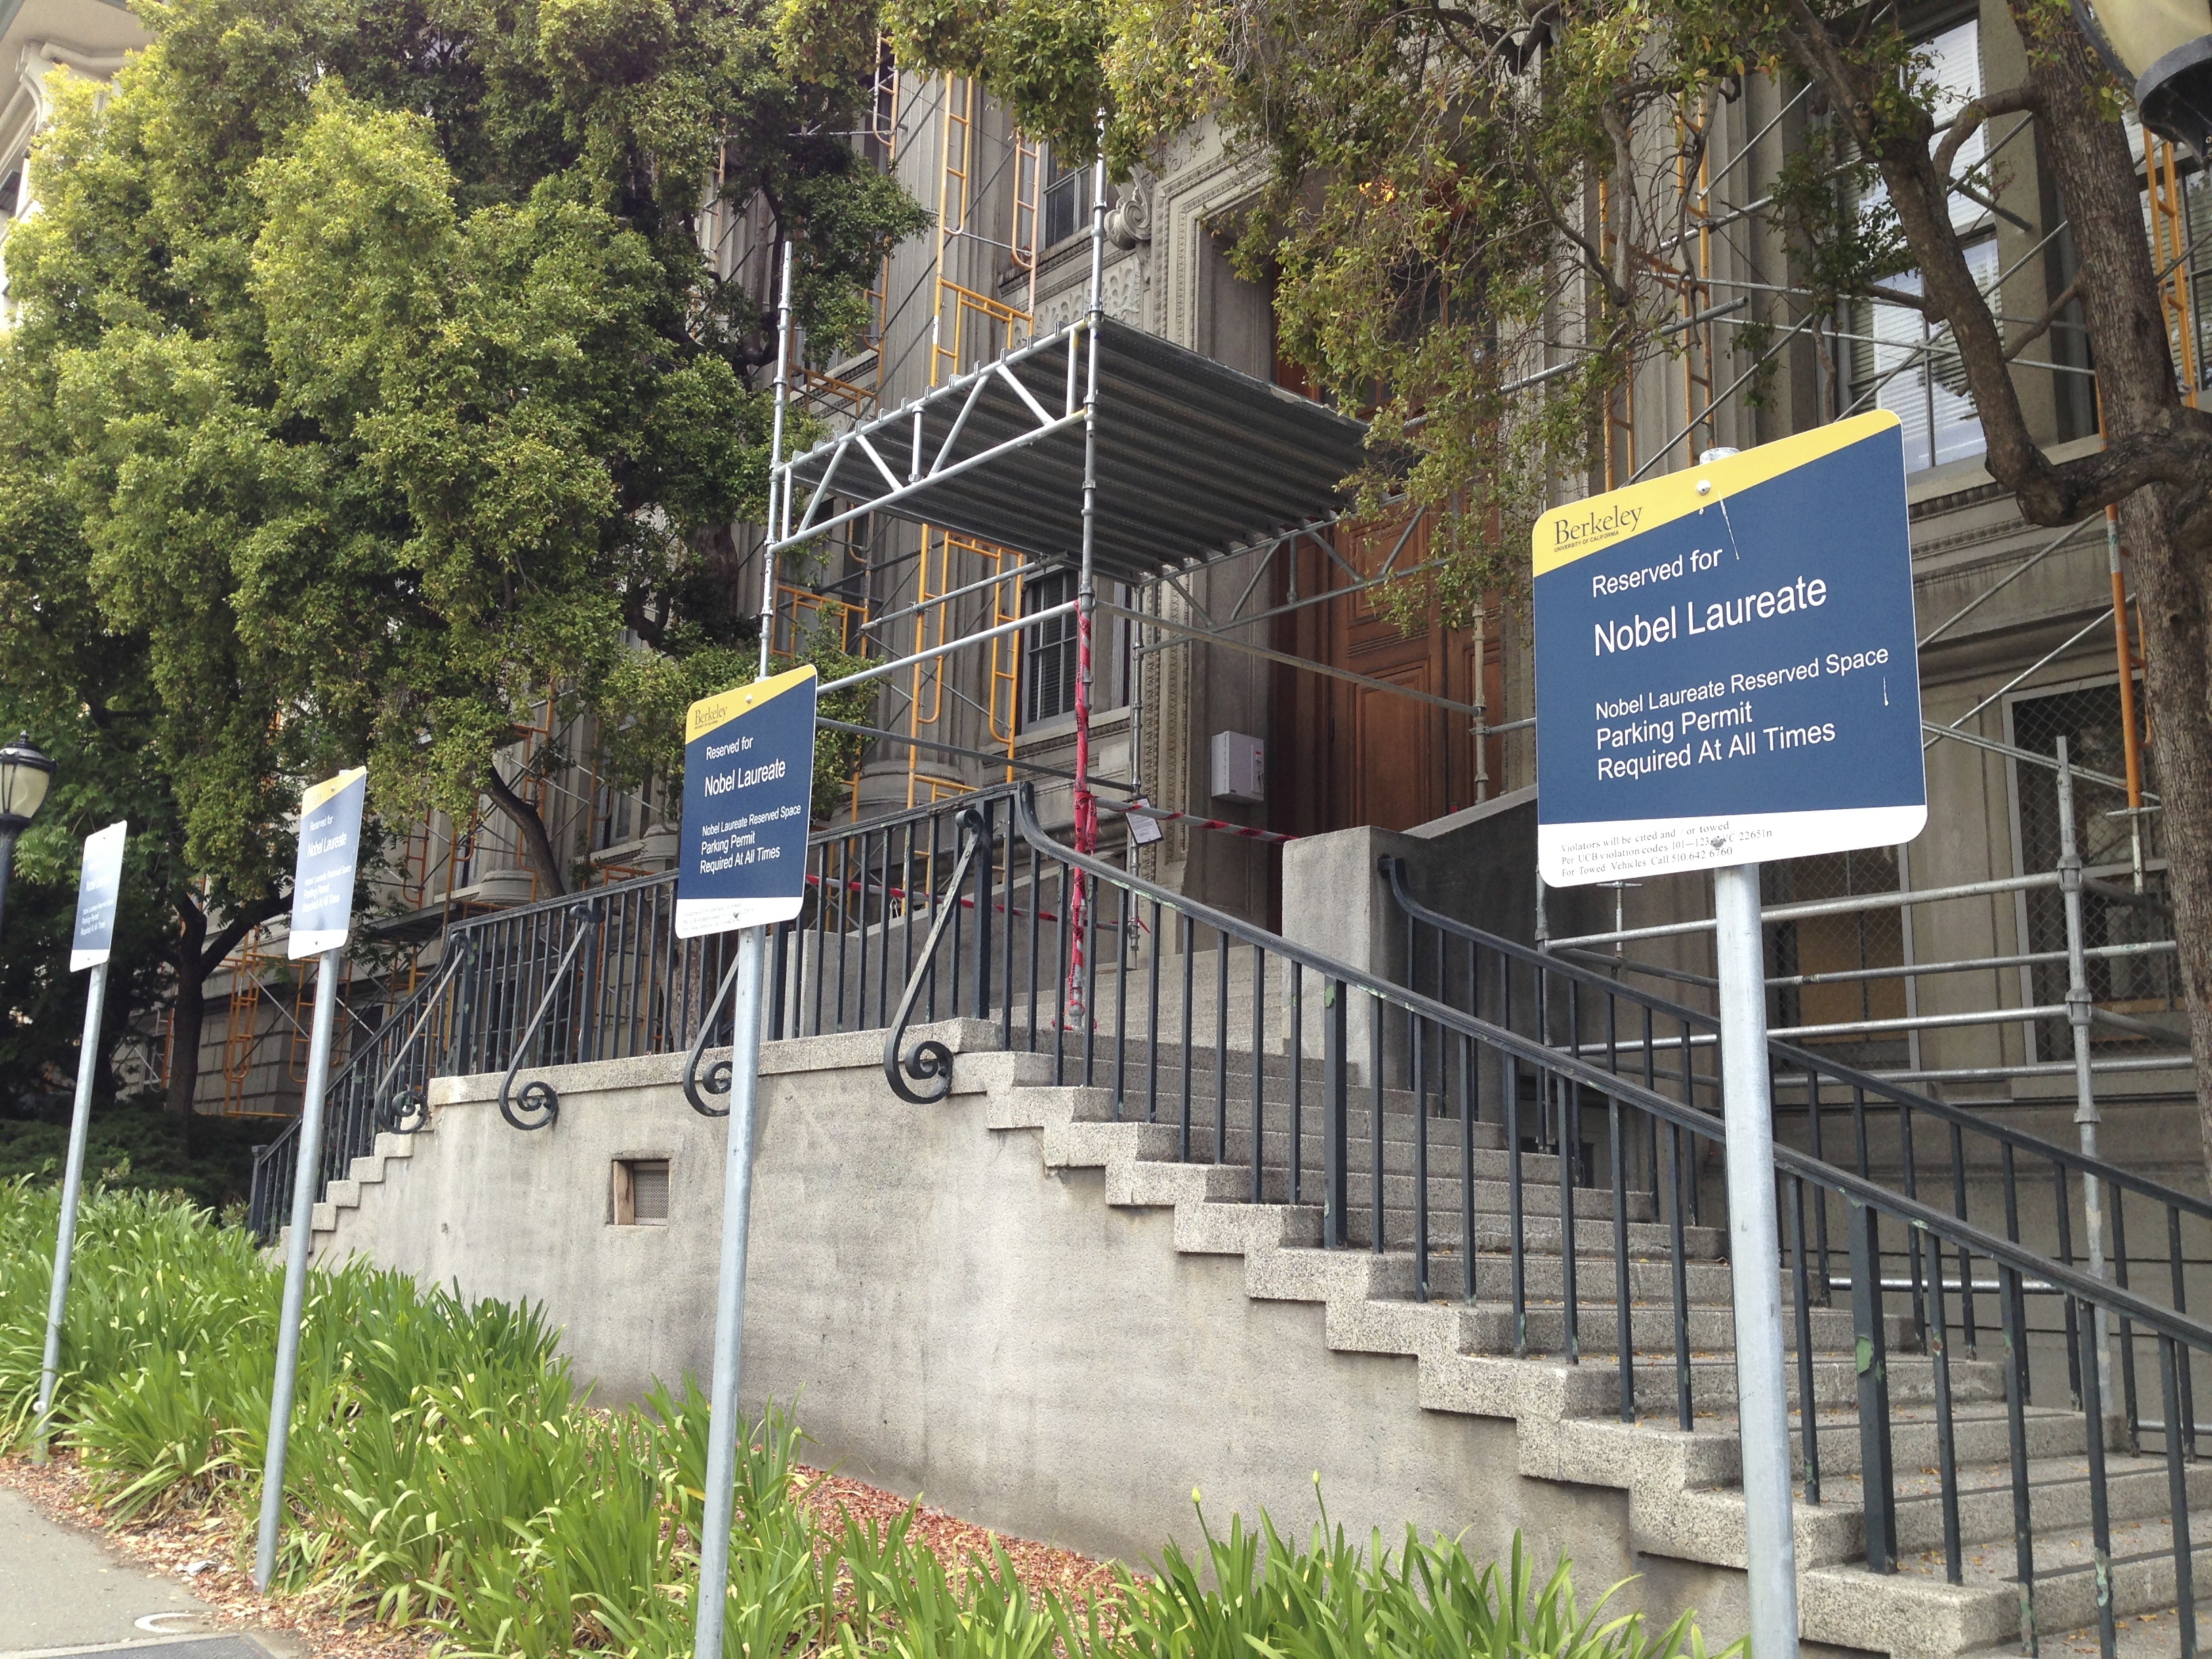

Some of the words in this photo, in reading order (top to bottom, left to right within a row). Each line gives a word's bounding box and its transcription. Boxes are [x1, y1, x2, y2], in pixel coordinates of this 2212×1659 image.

[1553, 505, 1643, 545] Berkeley
[1554, 541, 1581, 552] UNIVERSITY
[1591, 531, 1620, 542] CALIFORNIA
[1592, 555, 1683, 598] Reserved
[1689, 548, 1723, 573] for
[1594, 606, 1677, 657] Nobel
[1687, 575, 1828, 635] Laureate
[1595, 694, 1643, 720] Nobel
[1648, 680, 1725, 710] Laureate
[1730, 657, 1819, 693] Reserved
[1825, 648, 1889, 676] Space
[695, 704, 727, 725] Berkeley
[1597, 719, 1674, 750] Parking
[1681, 701, 1753, 735] Permit
[706, 738, 739, 760] Reserved
[741, 736, 754, 750] for
[1597, 743, 1691, 781] Required
[1698, 739, 1722, 764] At
[1728, 731, 1756, 758] All
[1763, 722, 1836, 752] Times
[704, 769, 735, 797] Nobel
[737, 758, 786, 789] Laureate
[701, 822, 720, 837] Nobel
[720, 817, 747, 833] Laureate
[749, 807, 779, 826] Reserved
[780, 804, 802, 820] Space
[701, 838, 729, 855] Parking
[731, 830, 756, 848] Permit
[1561, 842, 1601, 853] Violators
[1603, 836, 1619, 846] will
[1622, 836, 1631, 844] be
[1635, 832, 1658, 842] cited
[1660, 829, 1675, 839] and
[1699, 821, 1729, 833] towed
[699, 854, 733, 875] Required
[734, 852, 743, 866] At
[744, 848, 755, 865] All
[756, 846, 781, 861] Times
[1561, 857, 1574, 865] Per
[1578, 853, 1598, 863] UCB
[1600, 848, 1640, 859] violation
[1641, 844, 1668, 854] codes
[1561, 869, 1575, 877] For
[1580, 864, 1605, 875] Towed
[1611, 859, 1646, 870] Vehicles
[1651, 855, 1668, 865] Call
[1709, 847, 1732, 858] 6760
